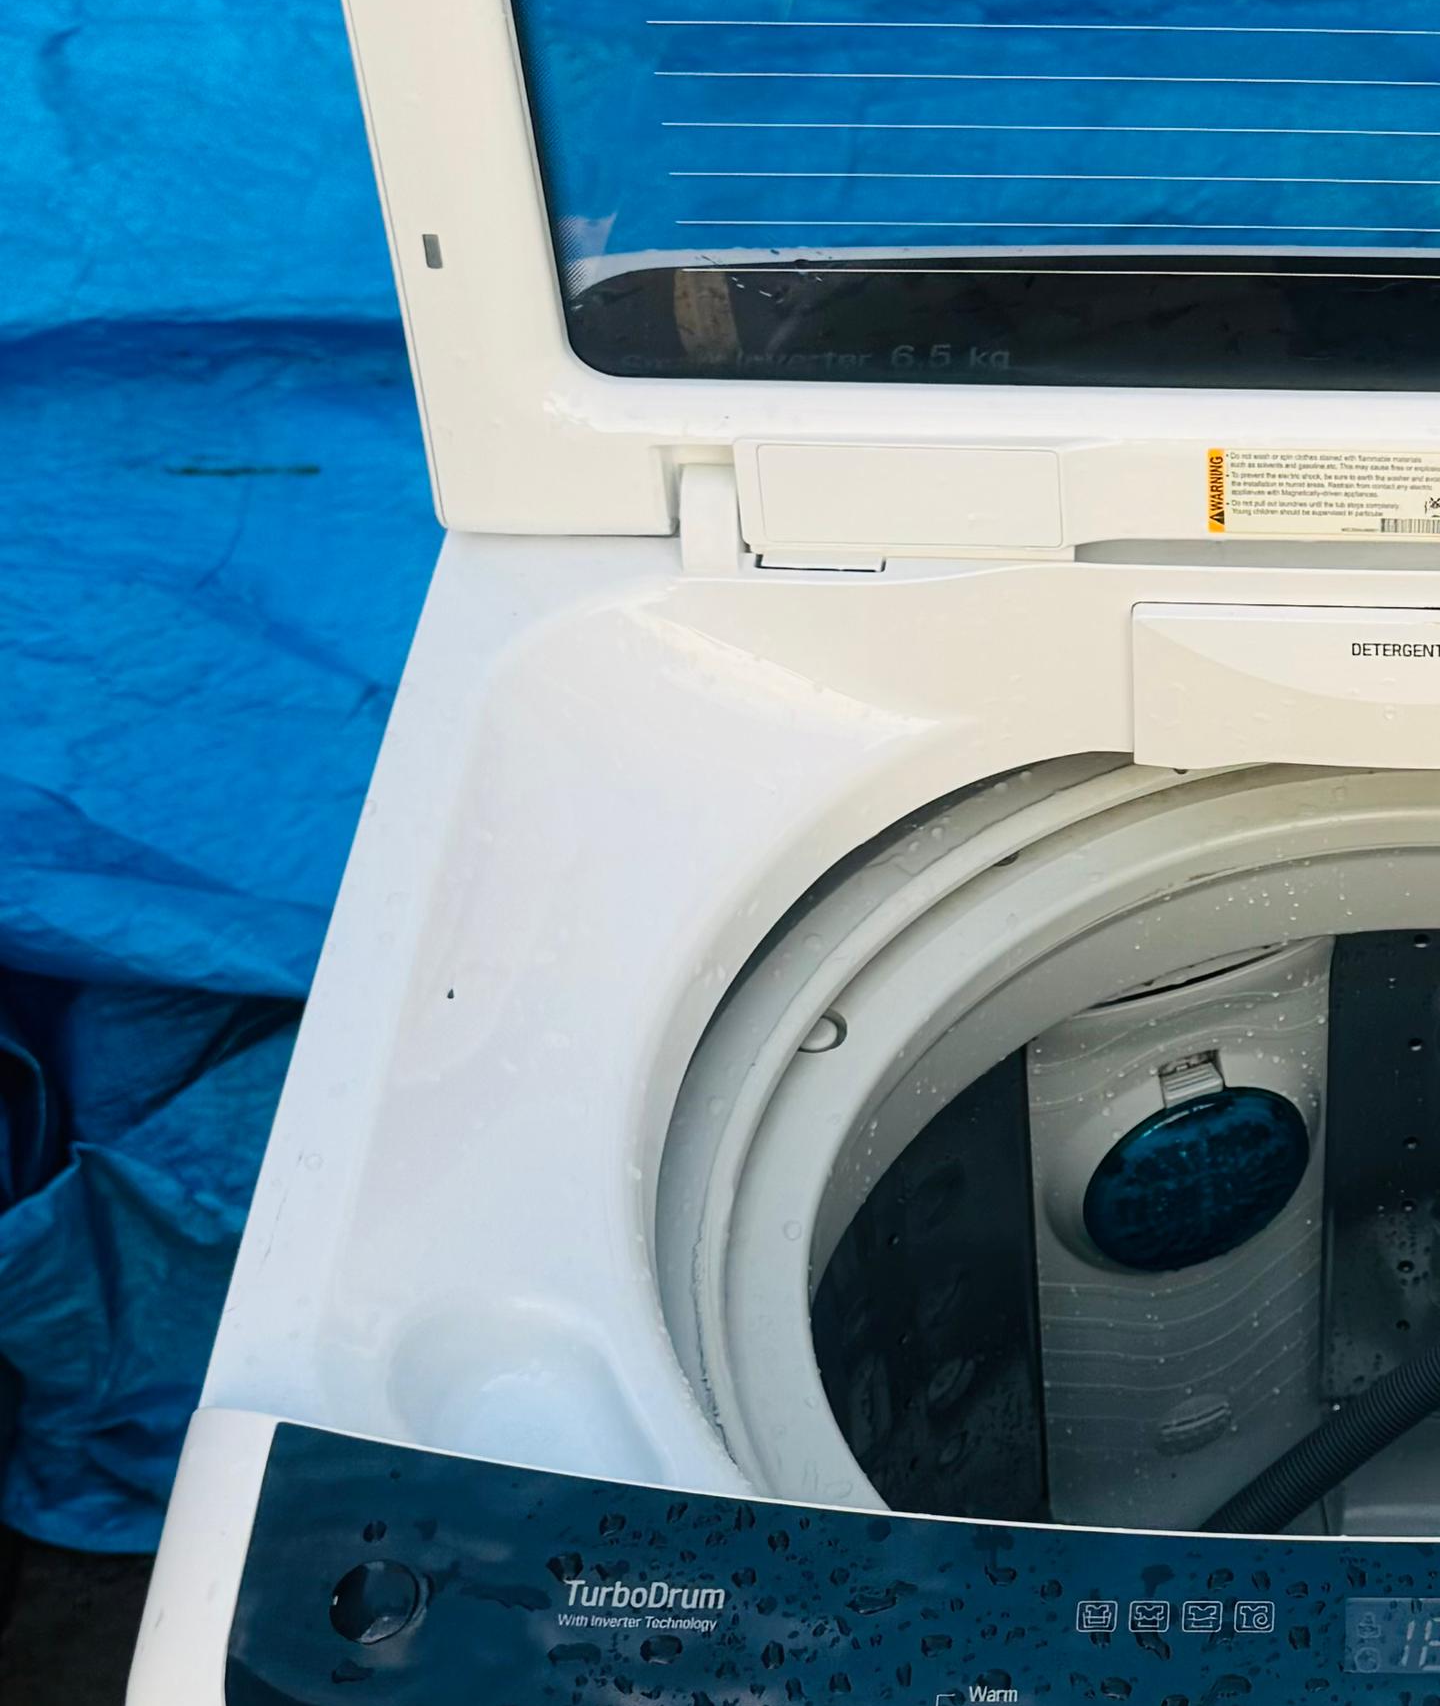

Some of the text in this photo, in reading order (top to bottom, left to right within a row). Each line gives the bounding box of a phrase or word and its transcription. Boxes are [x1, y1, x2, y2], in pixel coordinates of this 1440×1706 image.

[1209, 456, 1224, 511] WARNING
[566, 1579, 726, 1610] TurboDrum
[558, 1613, 718, 1632] With Inverter Technology
[969, 1686, 1019, 1703] Warm
